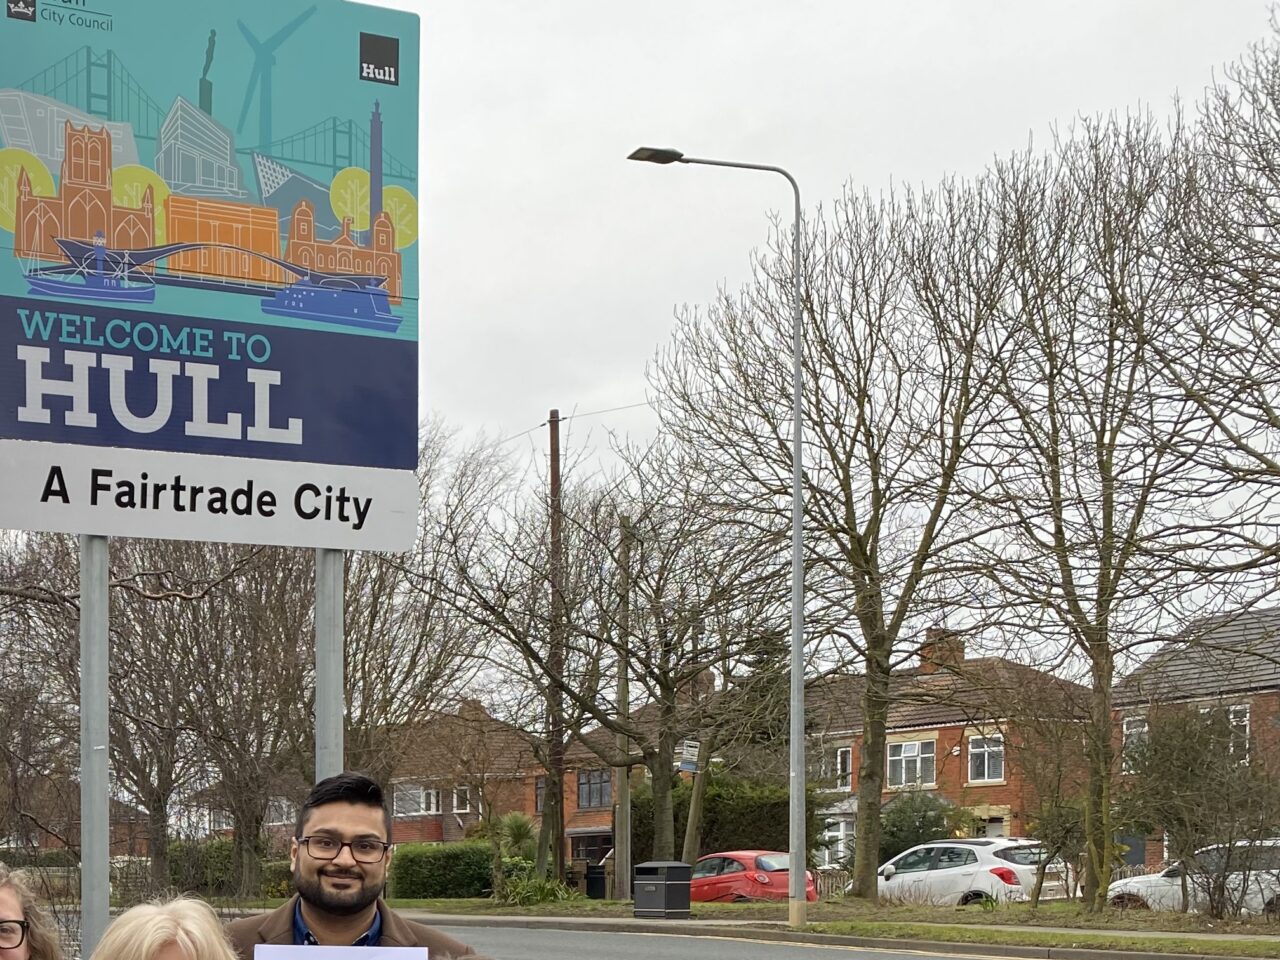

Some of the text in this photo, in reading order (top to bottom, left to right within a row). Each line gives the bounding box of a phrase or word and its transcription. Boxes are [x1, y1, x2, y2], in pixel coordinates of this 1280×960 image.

[40, 8, 112, 32] City Council
[362, 63, 396, 82] Hull
[16, 308, 272, 363] WELCOME TO
[16, 344, 303, 445] HULL
[40, 465, 373, 530] A Fairtrade City
